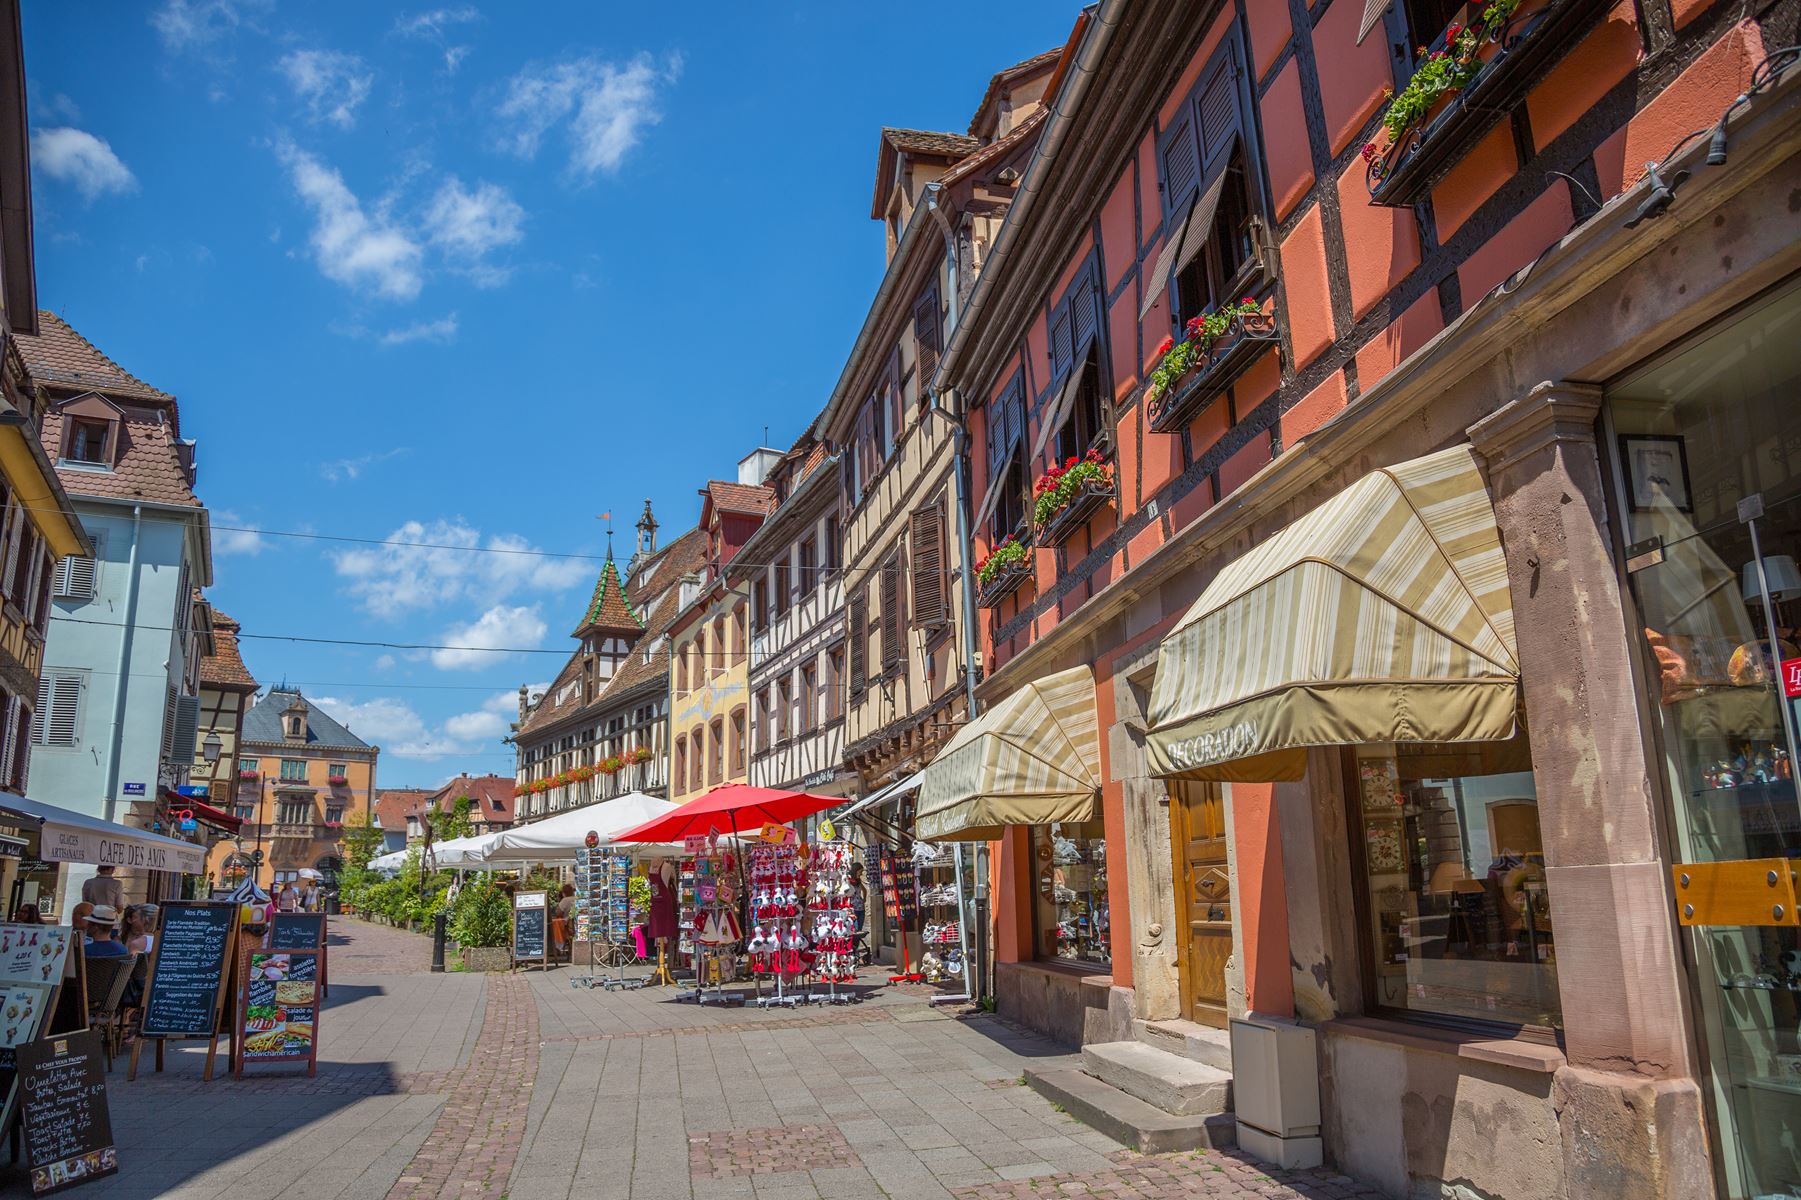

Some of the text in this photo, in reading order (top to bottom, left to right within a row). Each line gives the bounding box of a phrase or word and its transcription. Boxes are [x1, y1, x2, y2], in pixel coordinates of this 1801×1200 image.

[60, 834, 78, 846] GLACES
[50, 847, 84, 860] ARTISANALES
[100, 840, 124, 865] CAFE
[128, 844, 144, 867] DES
[146, 847, 166, 868] AMIS
[294, 958, 315, 970] assiette
